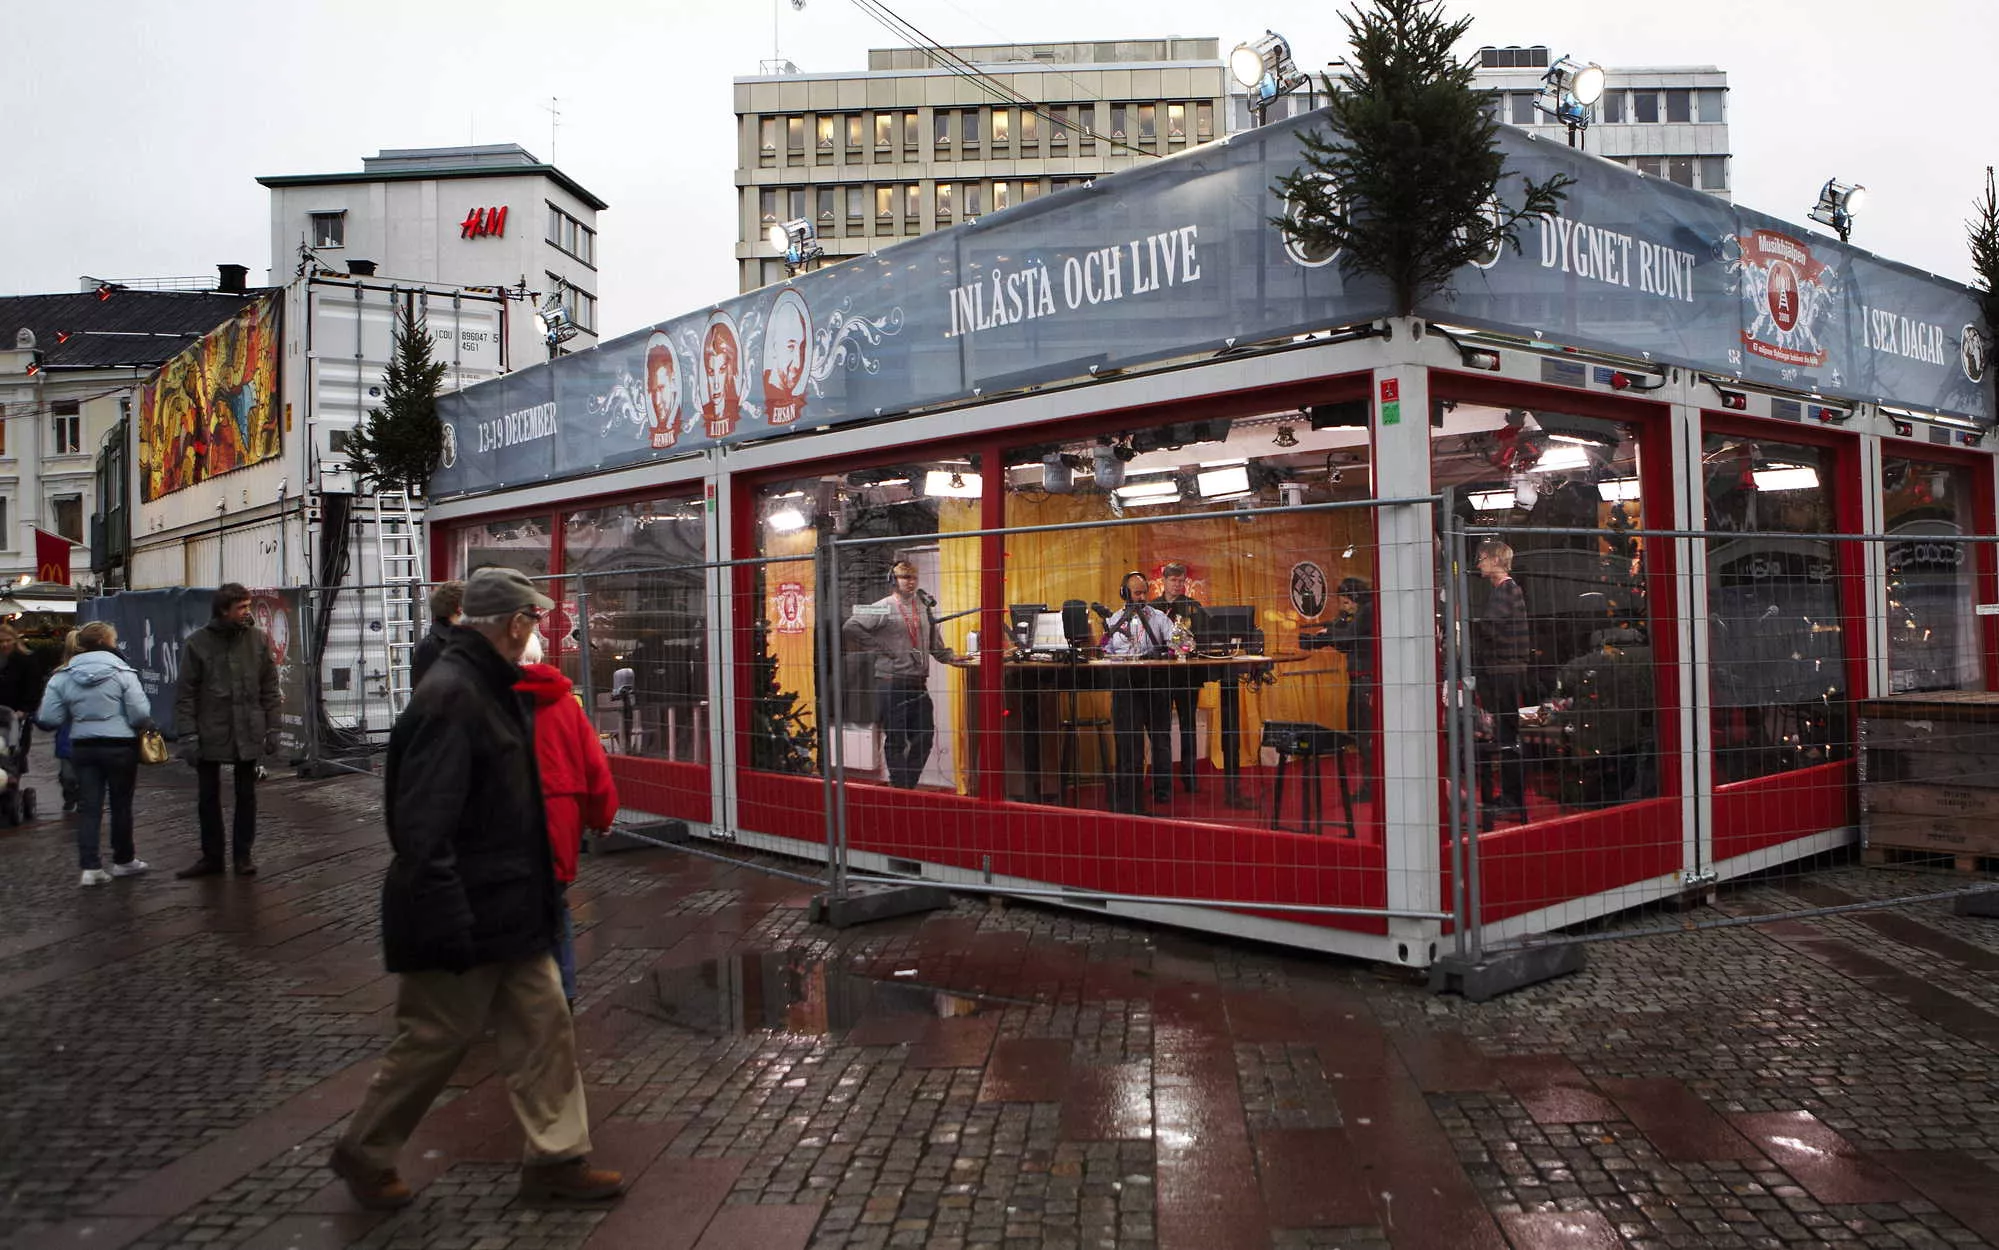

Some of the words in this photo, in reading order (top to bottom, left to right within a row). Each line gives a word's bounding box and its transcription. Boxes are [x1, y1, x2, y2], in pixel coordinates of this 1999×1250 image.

[460, 206, 508, 240] H&M
[949, 265, 1056, 337] INLÅSTA
[1063, 245, 1123, 310] OCH
[1130, 224, 1200, 295] LIVE
[1541, 212, 1632, 288] DYGNET
[1638, 240, 1696, 303] RUNT
[1862, 305, 1869, 348] I
[1872, 309, 1899, 356] SEX
[1901, 317, 1945, 366] DAGAR
[477, 417, 504, 453] 13-19
[505, 401, 557, 446] DECEMBER
